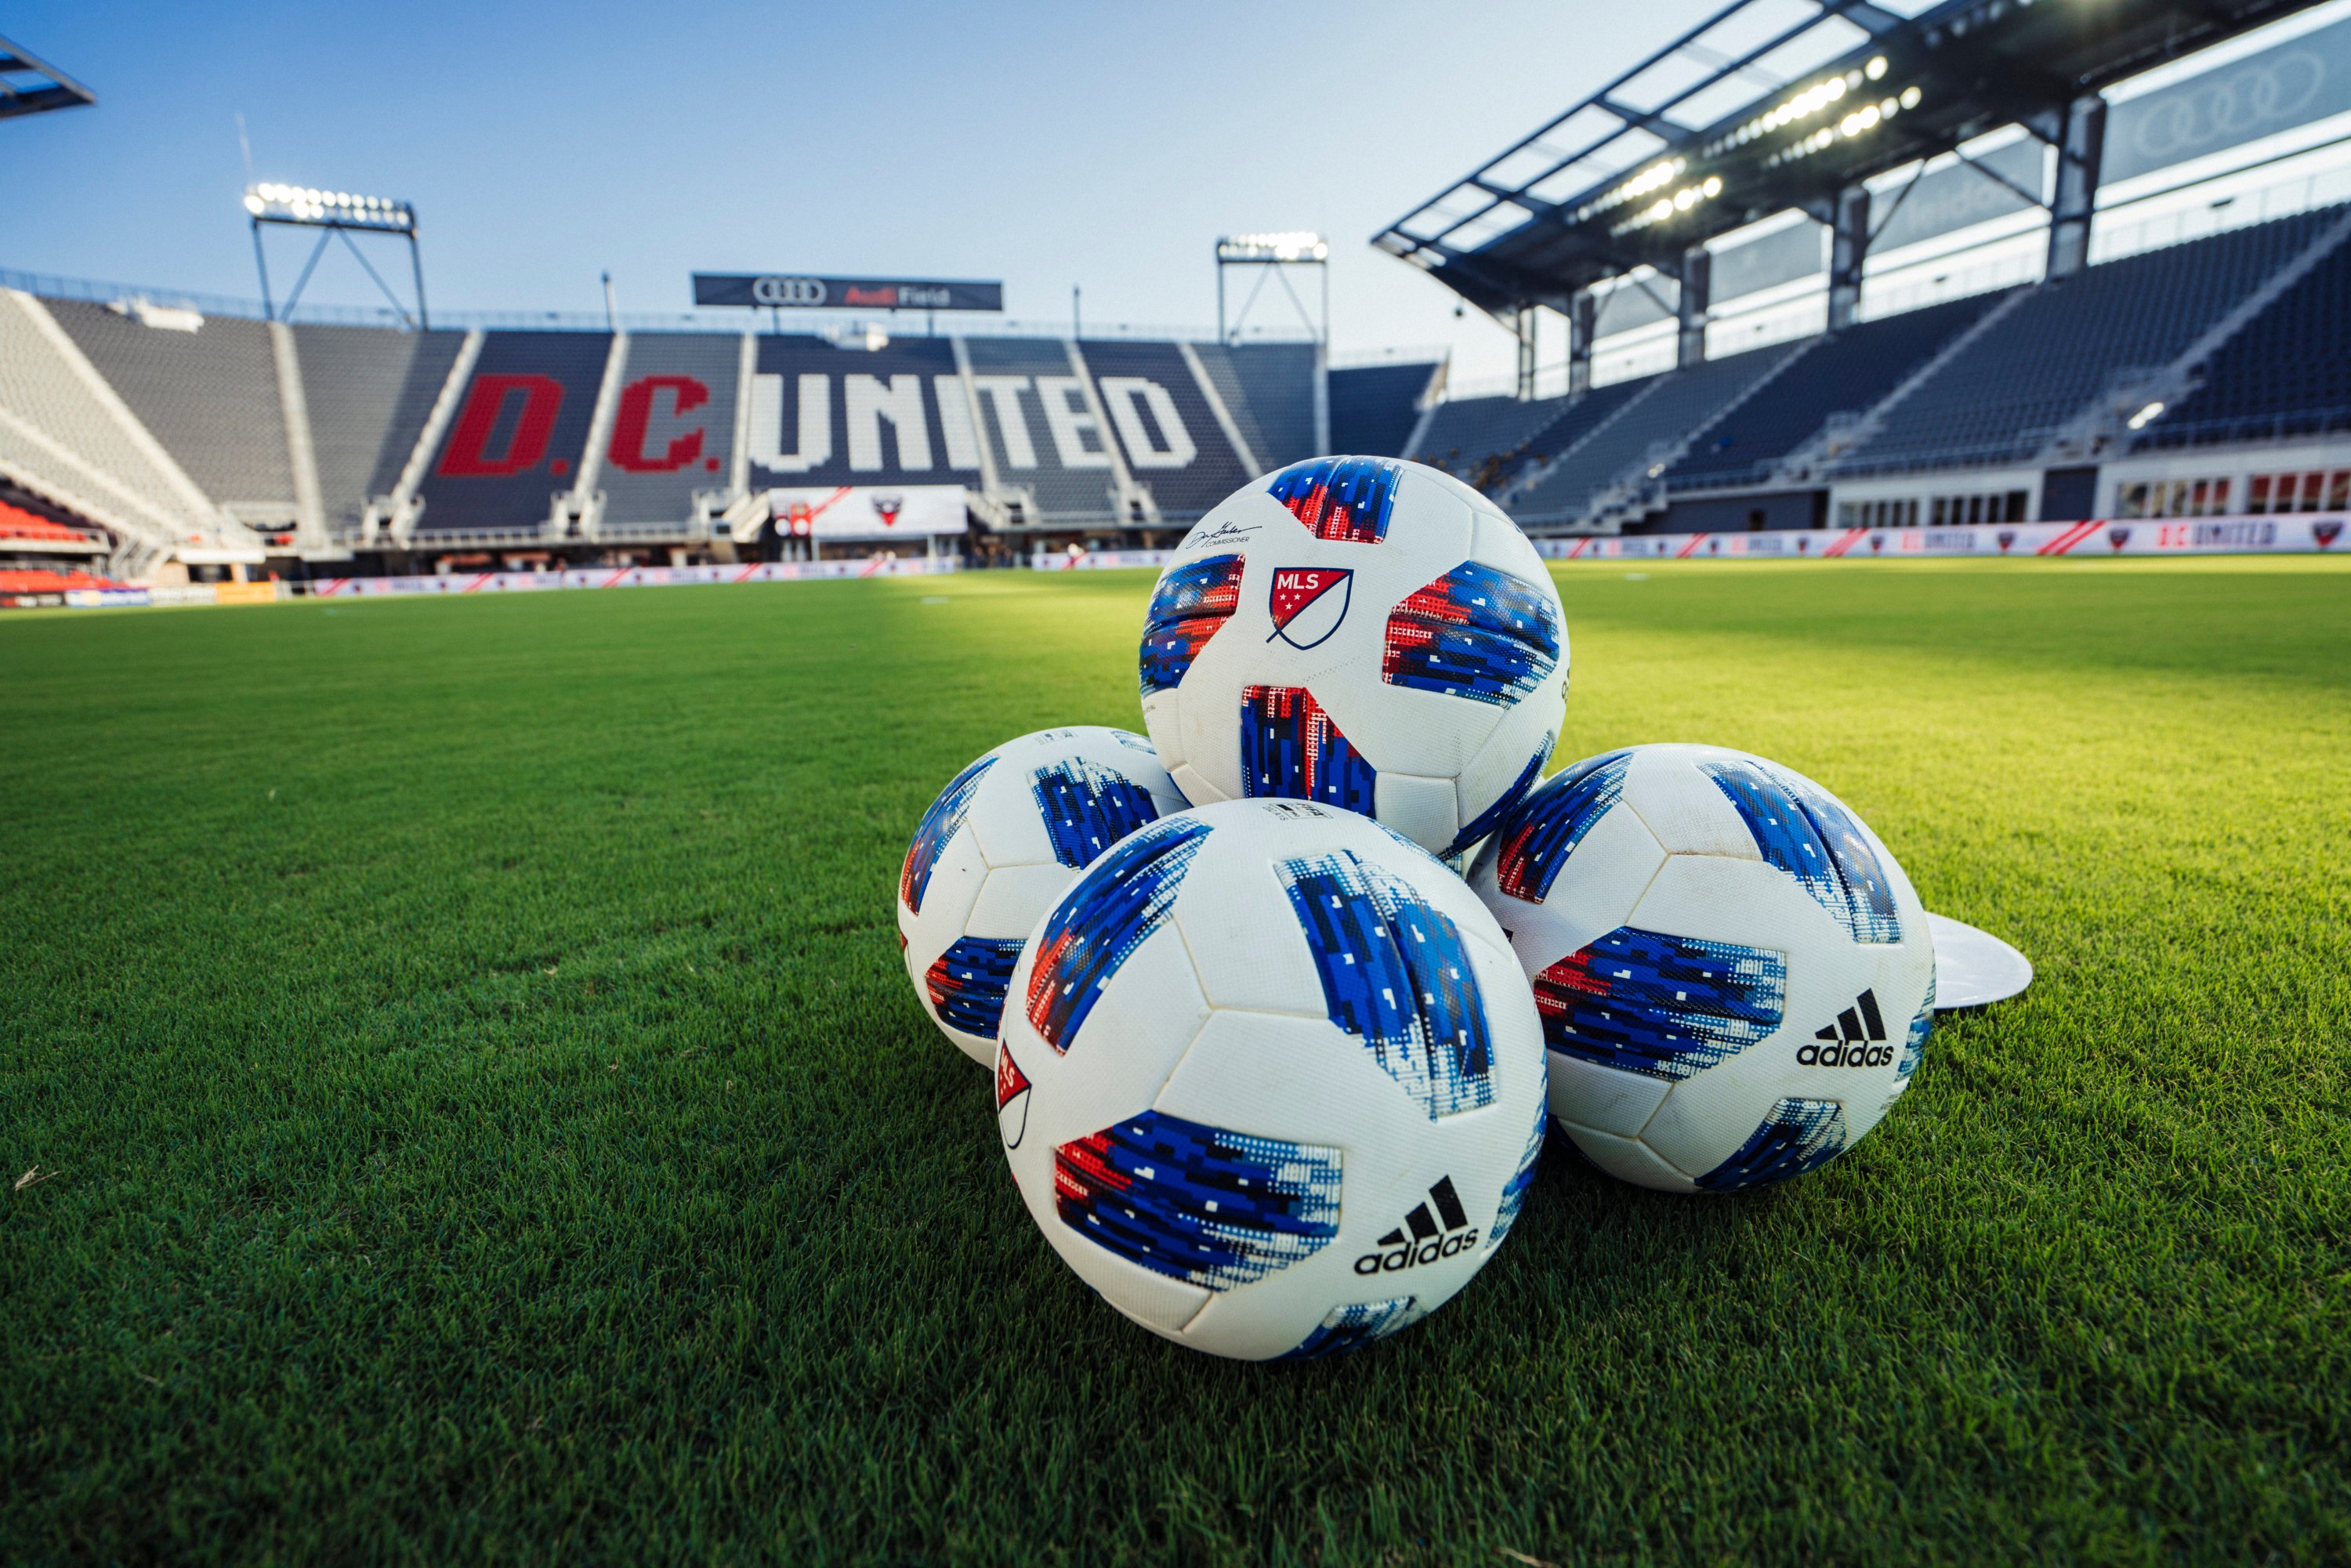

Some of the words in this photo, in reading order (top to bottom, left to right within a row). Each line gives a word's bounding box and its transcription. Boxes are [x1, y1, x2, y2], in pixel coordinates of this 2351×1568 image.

[898, 286, 951, 308] Field
[748, 373, 1197, 473] UNITED
[1205, 536, 1250, 548] COMMISSIONER
[1277, 573, 1319, 590] MLS
[1796, 1040, 1894, 1067] adidas
[1353, 1228, 1480, 1276] adidas
